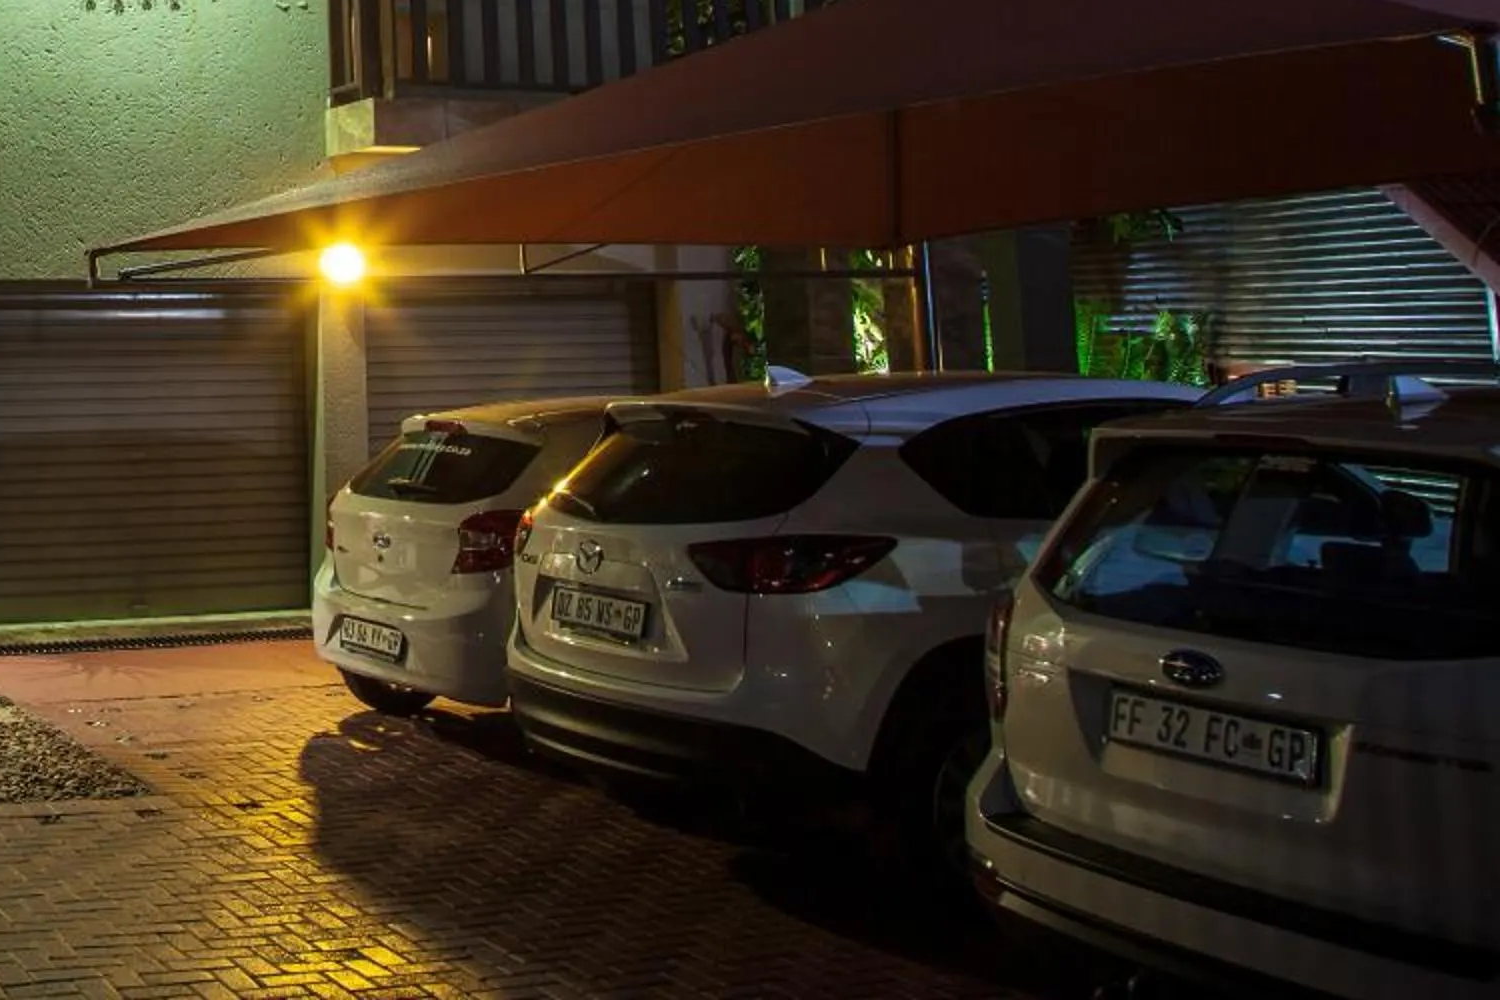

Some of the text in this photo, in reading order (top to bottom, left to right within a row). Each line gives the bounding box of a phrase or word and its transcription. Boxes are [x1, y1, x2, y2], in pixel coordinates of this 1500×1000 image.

[623, 604, 641, 632] GP
[1113, 697, 1145, 735] FF
[1157, 706, 1190, 749] 32
[1204, 714, 1239, 758] FC
[1267, 728, 1305, 772] GP
